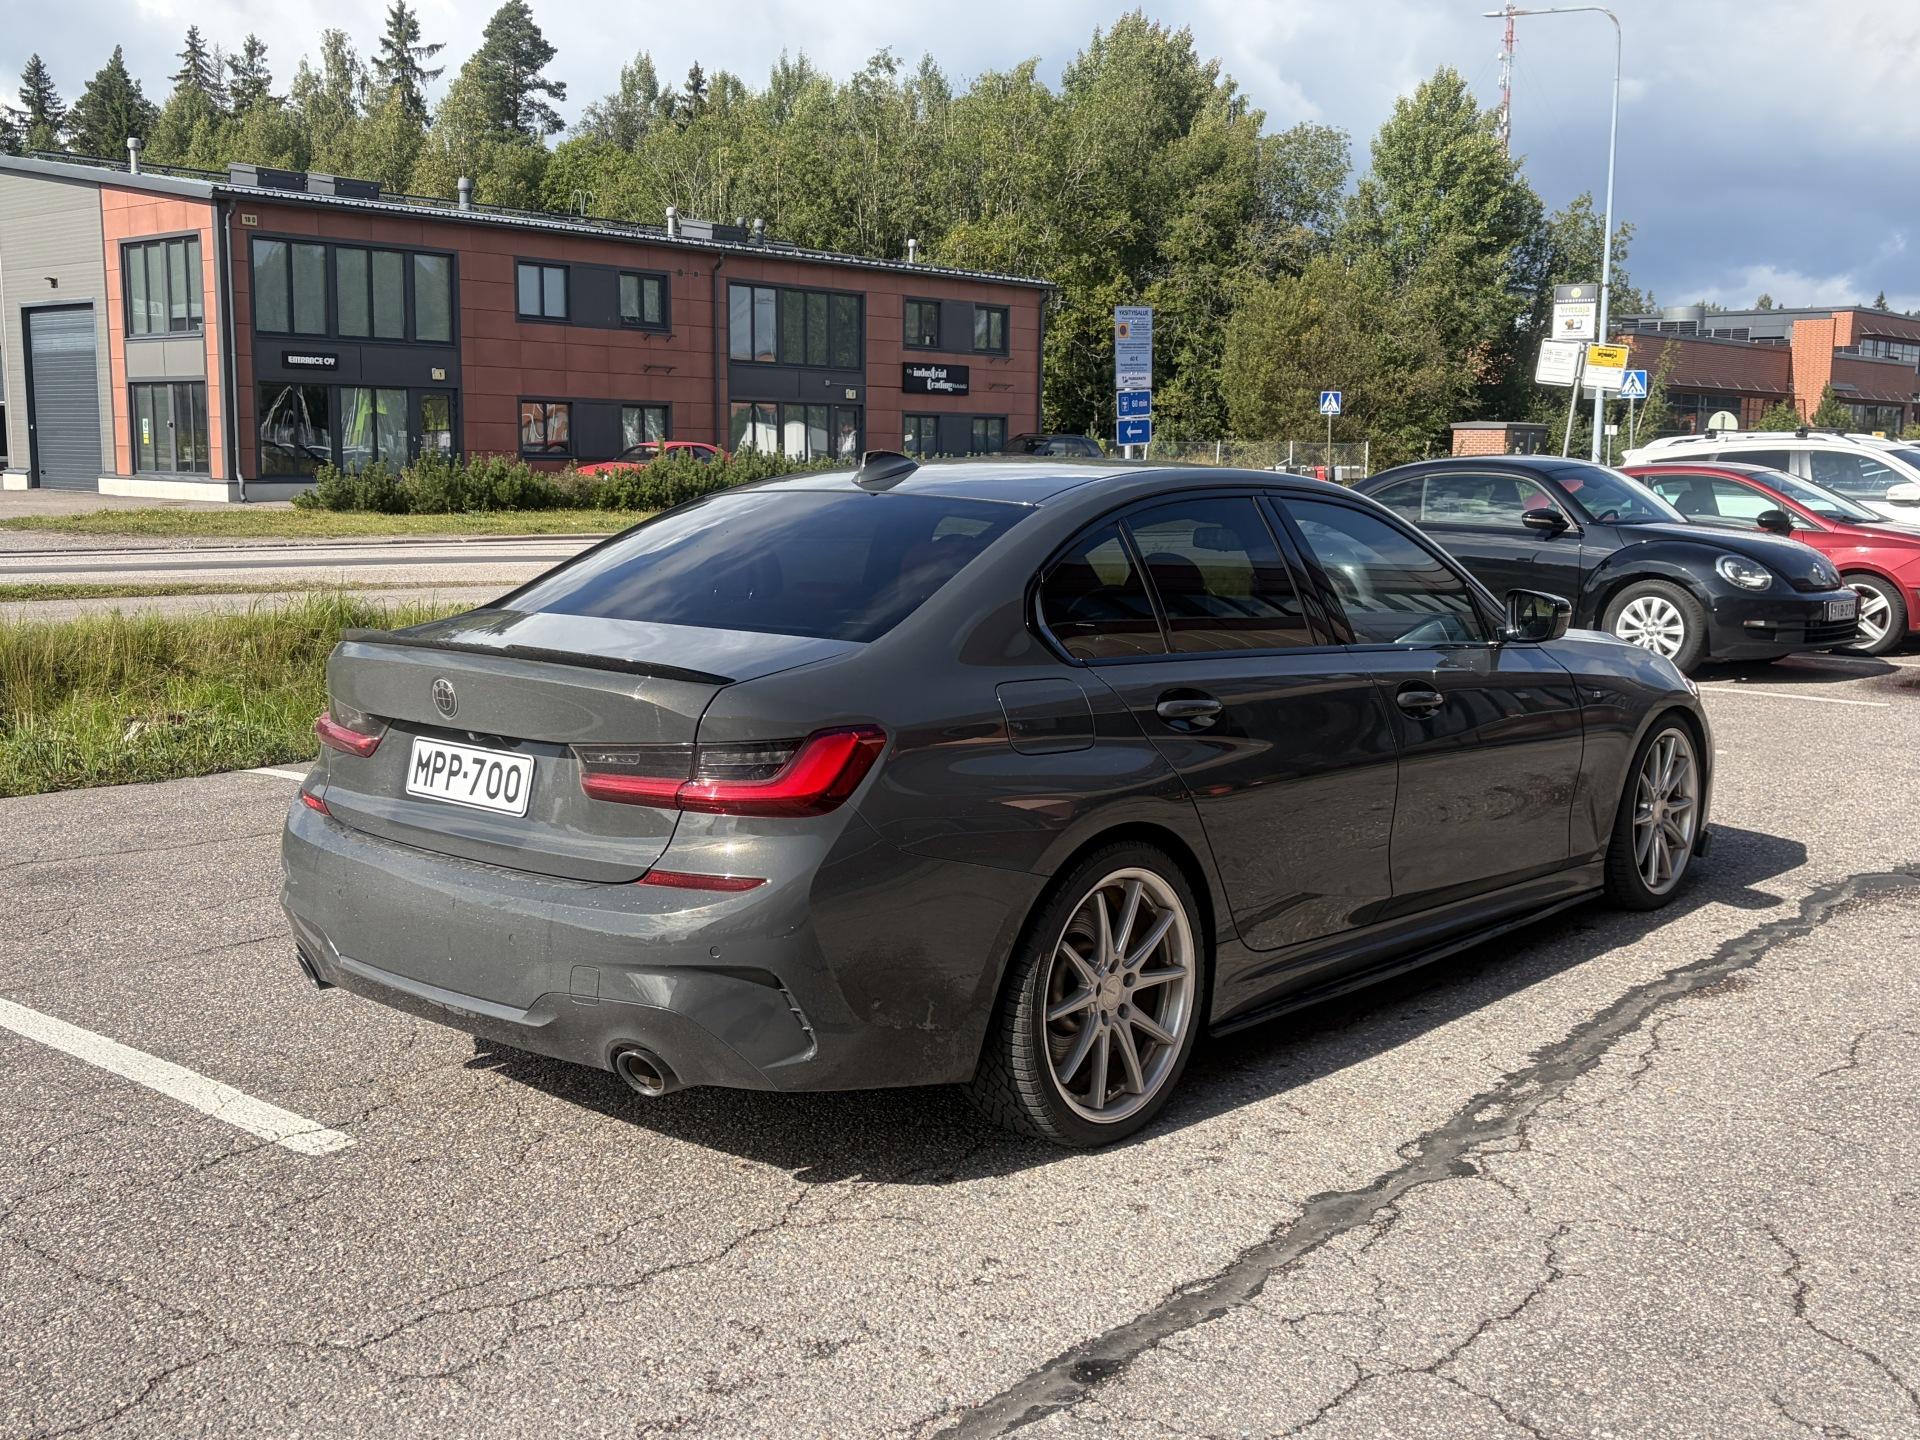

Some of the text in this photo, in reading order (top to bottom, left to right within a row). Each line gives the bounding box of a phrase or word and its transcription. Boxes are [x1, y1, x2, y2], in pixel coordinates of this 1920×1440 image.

[287, 355, 336, 366] ENTRANCE OY
[913, 366, 947, 380] industrial
[926, 377, 953, 392] trading
[1131, 399, 1139, 408] 60
[413, 747, 522, 803] MPP-700
